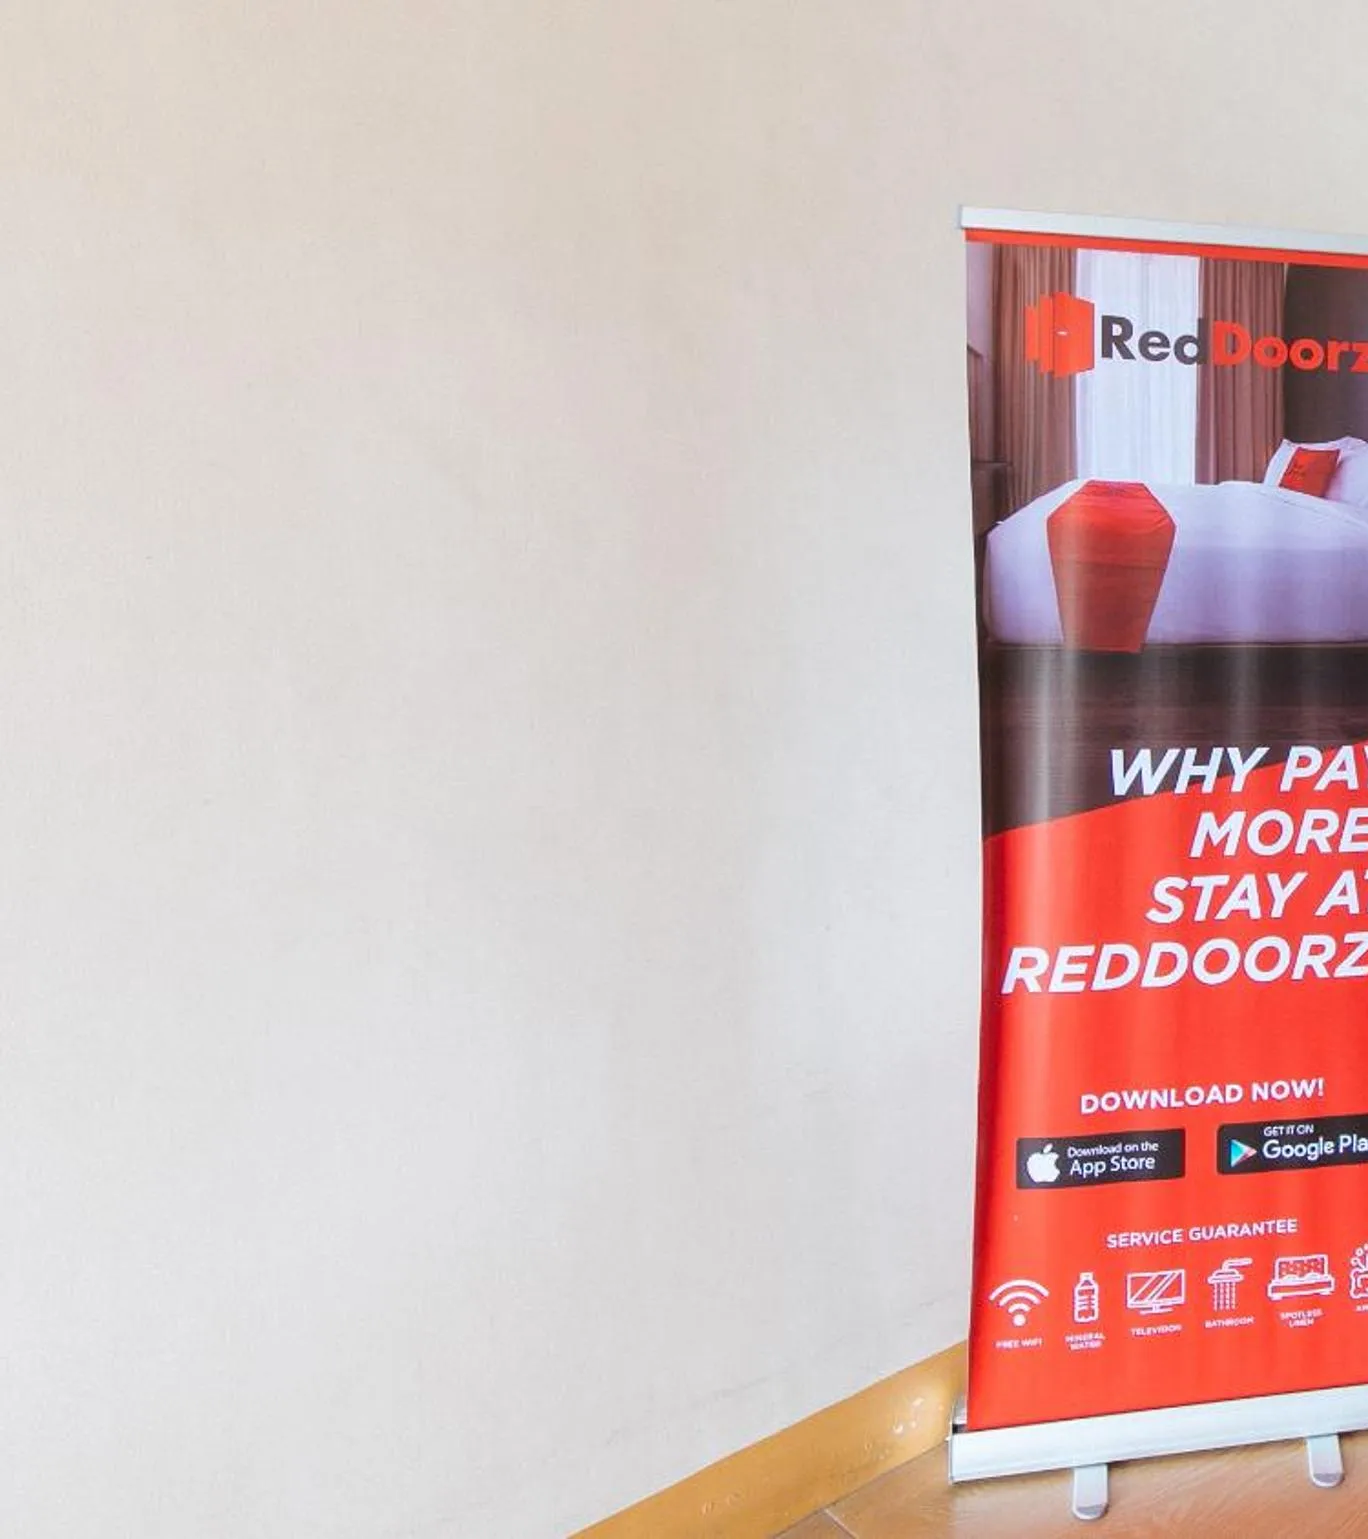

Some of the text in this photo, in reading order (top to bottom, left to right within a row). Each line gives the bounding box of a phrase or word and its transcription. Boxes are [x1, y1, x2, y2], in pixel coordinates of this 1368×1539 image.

[1110, 746, 1269, 796] WHY
[1146, 871, 1308, 924] STAY
[1081, 1077, 1325, 1115] DOWNLOAD NOW!
[1263, 1124, 1314, 1137] GET IT ON
[1067, 1140, 1159, 1158] Download on the
[1262, 1136, 1334, 1161] Google
[1070, 1155, 1155, 1178] App Store
[1107, 1218, 1298, 1249] SERVICE GUARANTEE
[1205, 1316, 1255, 1329] BATHROOM
[1280, 1308, 1324, 1321] SPOTLESS
[1289, 1318, 1315, 1328] LINEN
[1130, 1324, 1182, 1336] TELEVISION
[995, 1337, 1043, 1349] FREE WIFI
